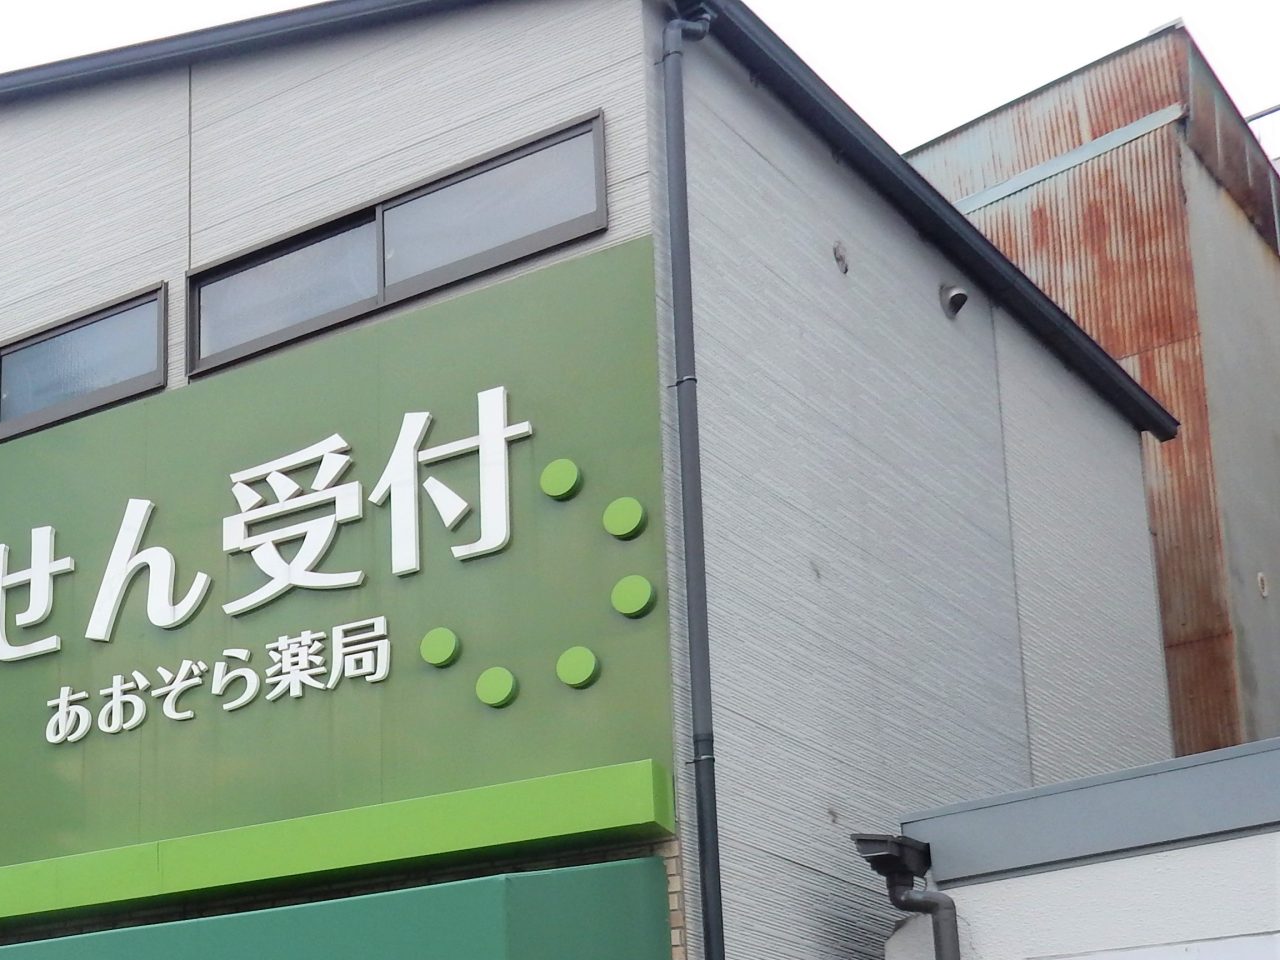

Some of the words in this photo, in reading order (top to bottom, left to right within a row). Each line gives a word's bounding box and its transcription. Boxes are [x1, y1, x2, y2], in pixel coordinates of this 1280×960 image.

[45, 616, 390, 745] あおぞら薬局
